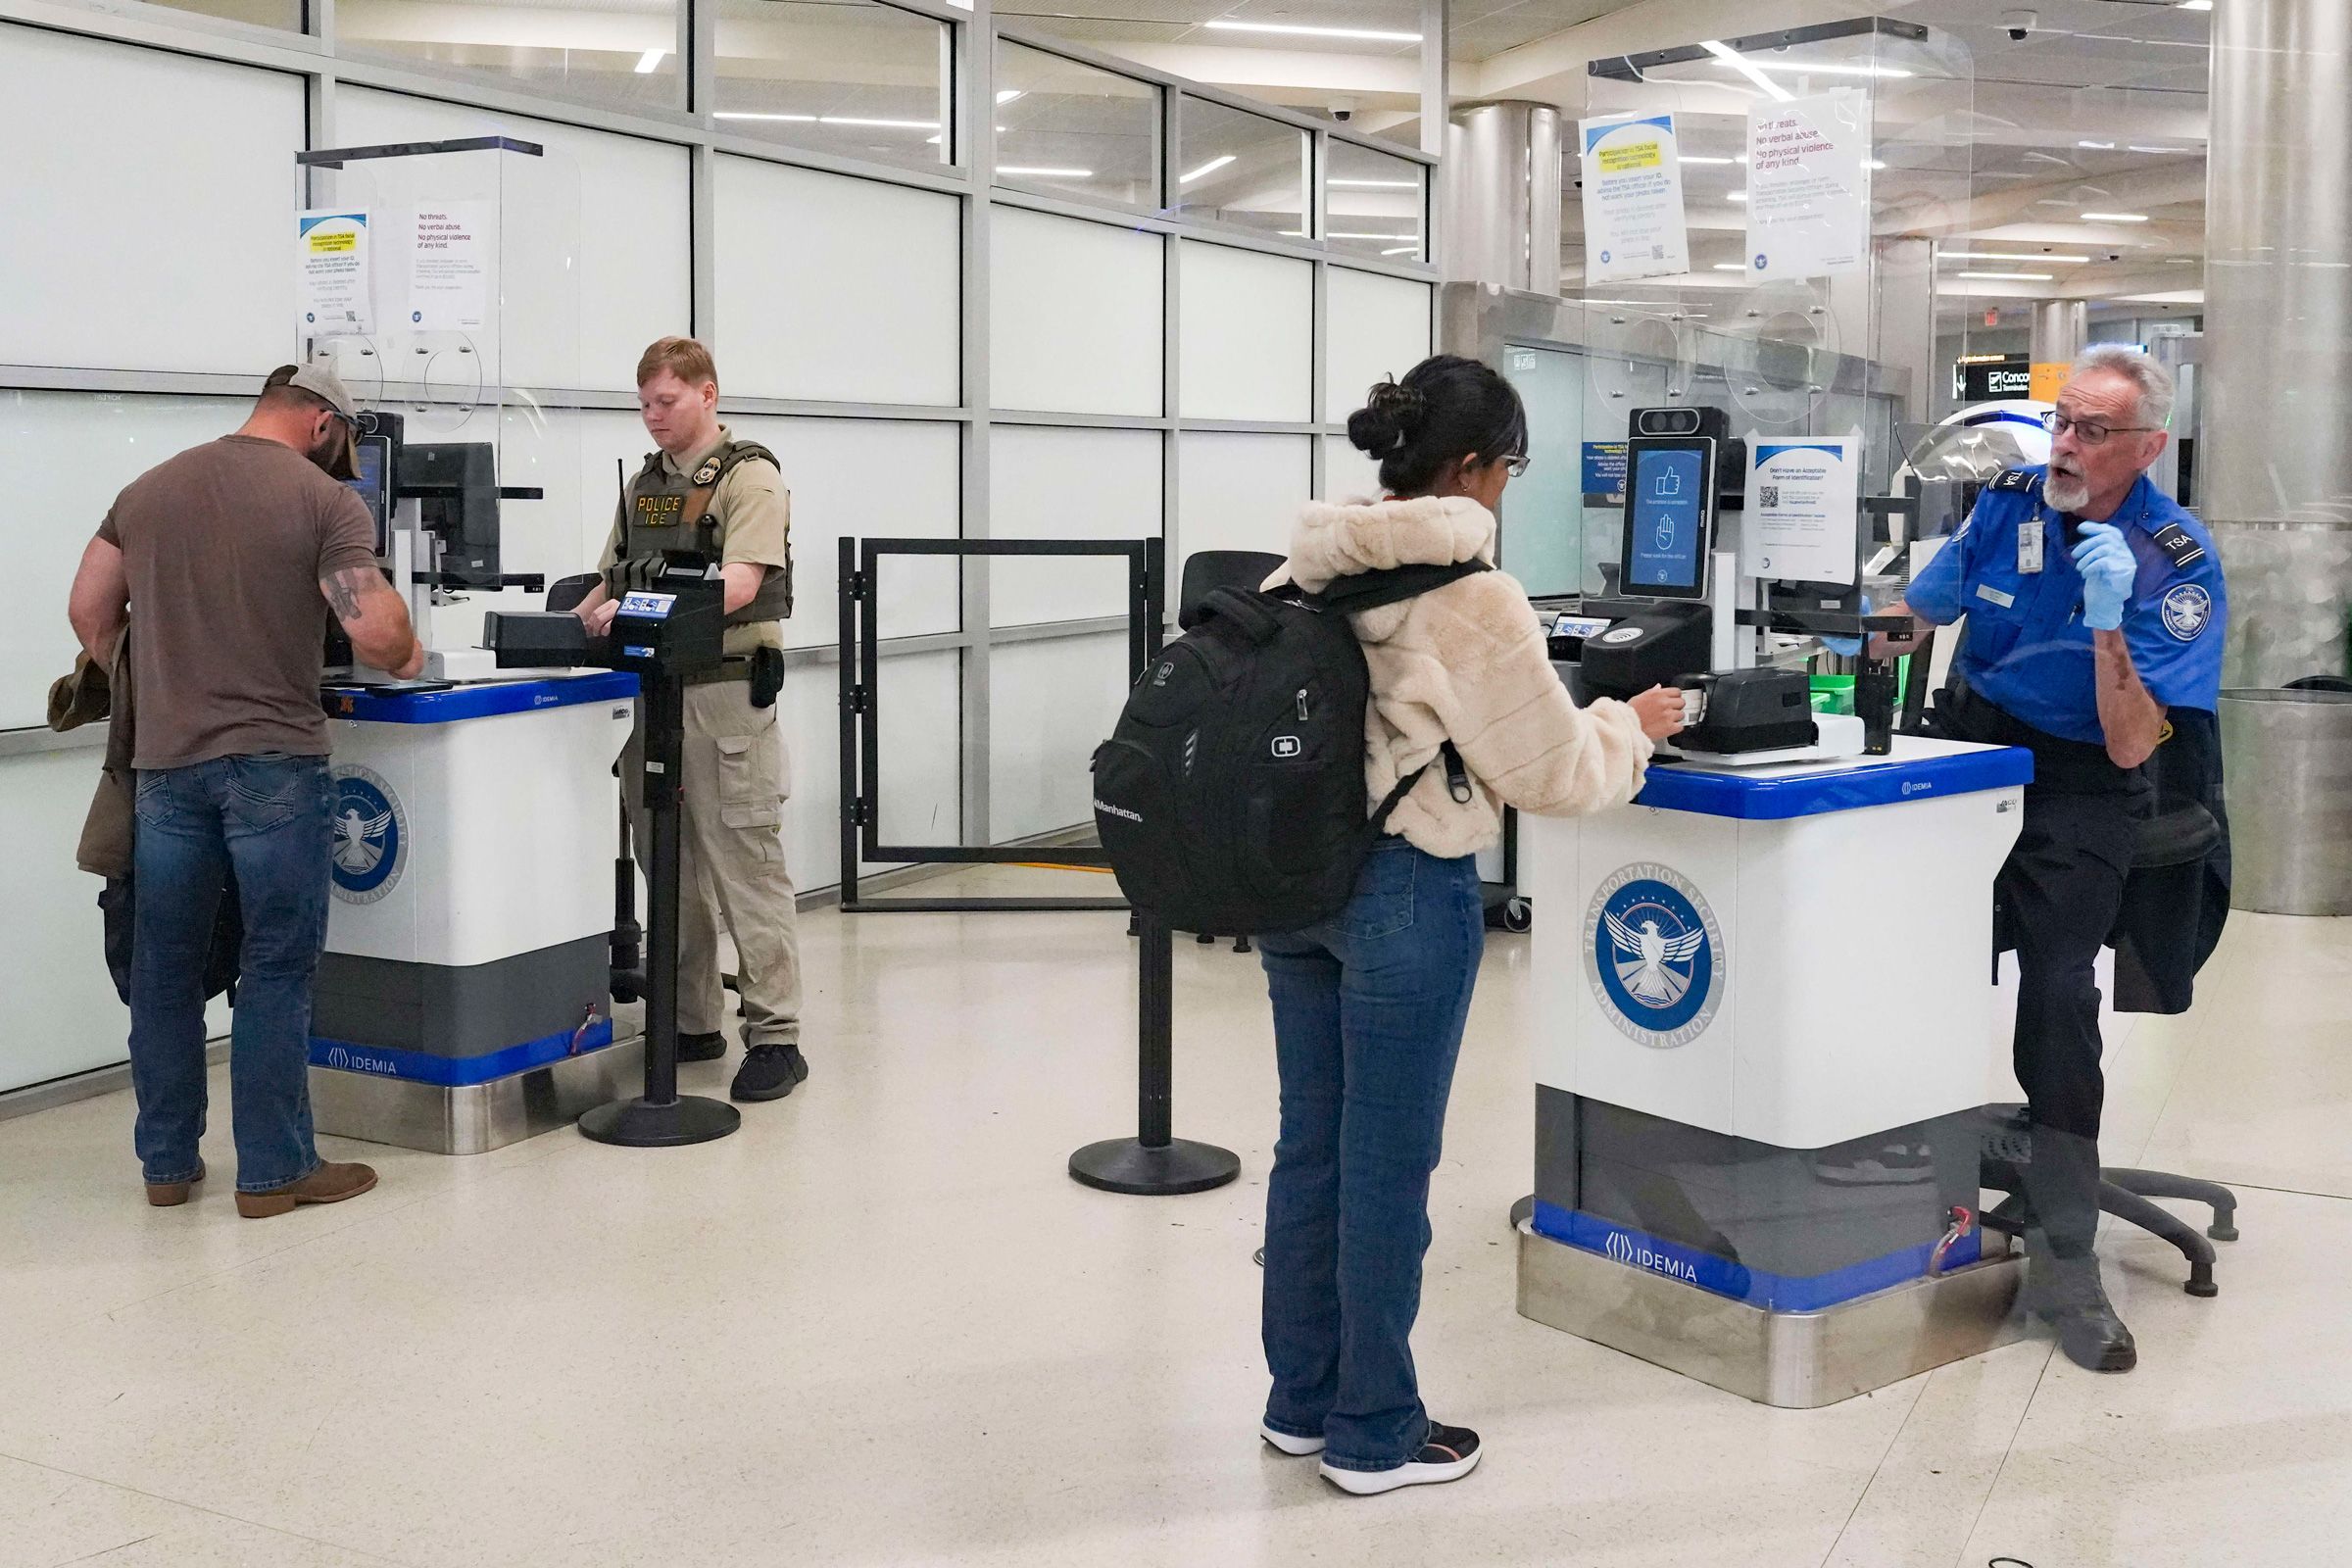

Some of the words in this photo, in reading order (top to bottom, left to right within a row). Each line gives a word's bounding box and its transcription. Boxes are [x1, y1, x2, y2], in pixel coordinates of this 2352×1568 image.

[1756, 136, 1767, 145] No
[1769, 133, 1792, 143] verbal
[1768, 146, 1799, 159] physical
[1801, 142, 1834, 153] violence
[1756, 160, 1764, 170] of
[1765, 160, 1780, 169] any
[2003, 371, 2030, 383] Conco
[2003, 471, 2023, 486] TSA
[638, 498, 680, 512] POLICE
[646, 514, 666, 524] ICE
[2165, 534, 2192, 550] TSA
[1912, 782, 1932, 791] IDEMIA
[1585, 865, 1684, 953] TRANSPORTATION
[1688, 889, 1725, 980] SECURITY
[1592, 982, 1712, 1047] ADMINISTRATION
[352, 1056, 396, 1074] IDEMIA
[1638, 1248, 1697, 1283] IDEMIA
